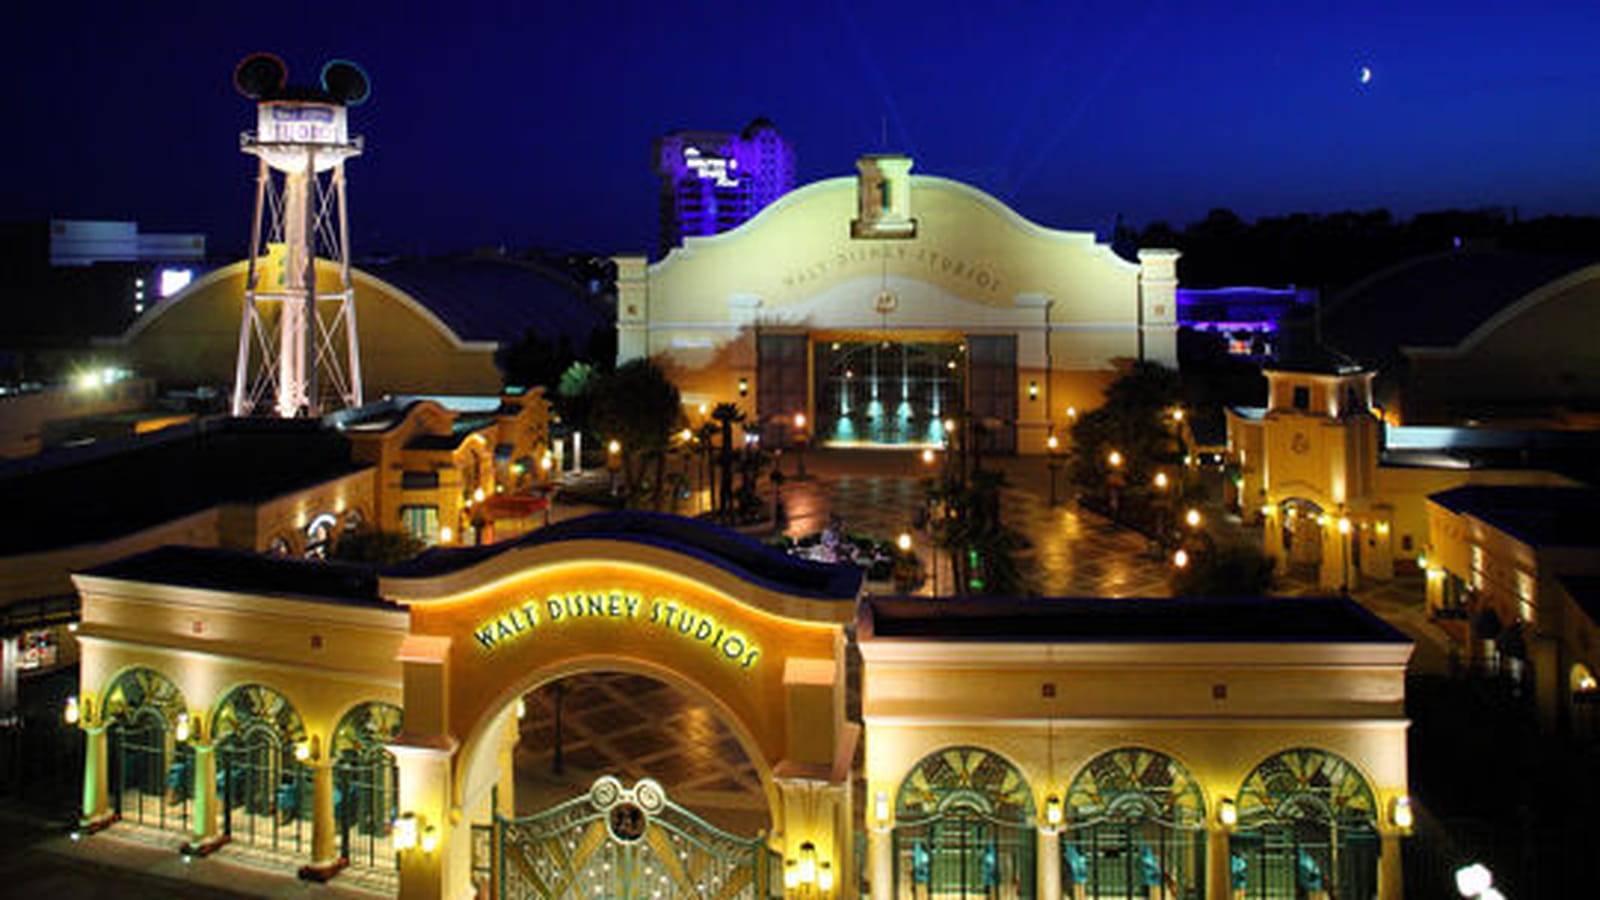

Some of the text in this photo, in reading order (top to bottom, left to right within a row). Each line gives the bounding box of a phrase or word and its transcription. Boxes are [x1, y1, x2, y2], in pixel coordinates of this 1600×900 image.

[474, 594, 759, 669] WALT DISNEY STUDIOS
